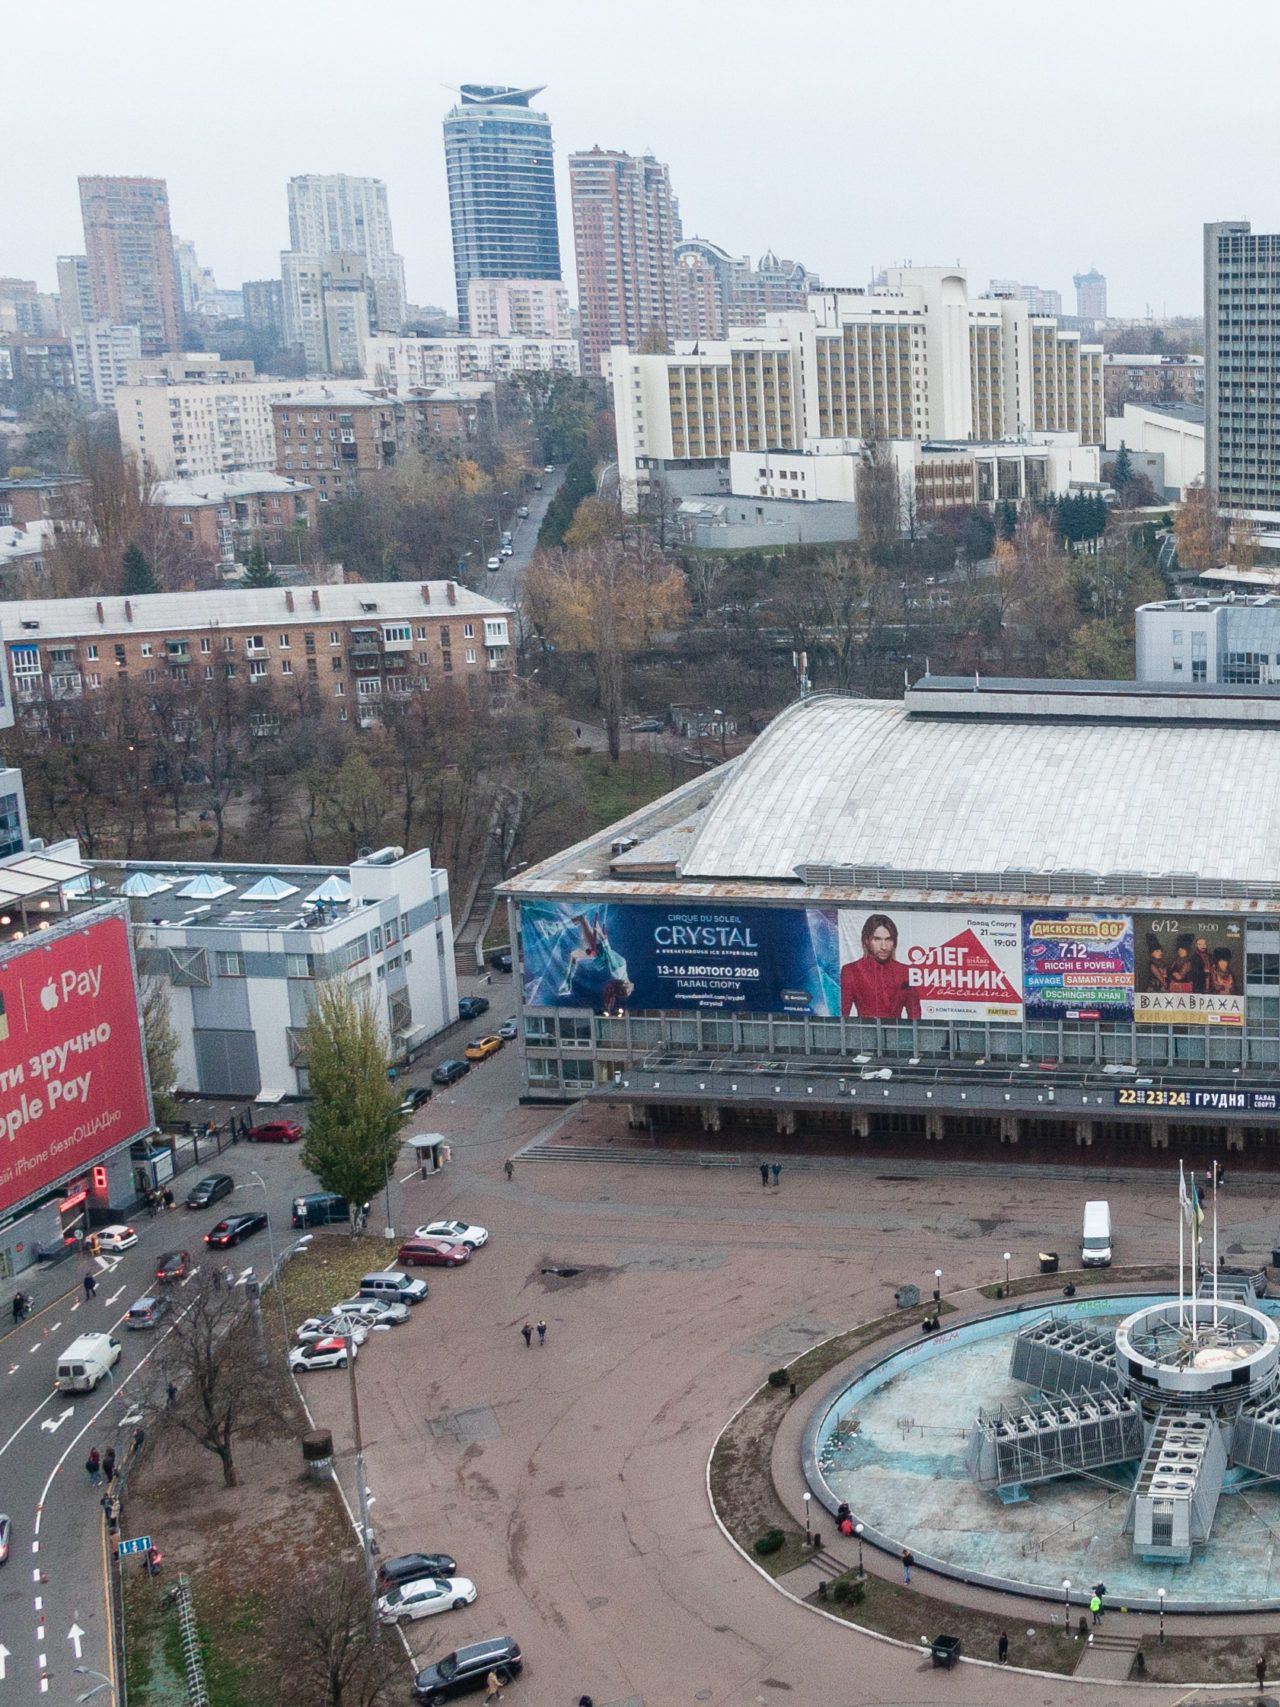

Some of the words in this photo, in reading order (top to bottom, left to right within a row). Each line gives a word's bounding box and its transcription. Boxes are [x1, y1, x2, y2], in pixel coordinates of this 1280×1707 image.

[668, 914, 699, 923] CIRQUE
[714, 915, 742, 923] SOLEIL
[991, 920, 1017, 928] Спорту
[980, 928, 988, 936] 21
[1034, 924, 1097, 935] ДИСКОТЕКА
[1151, 919, 1179, 933] 6/12
[1198, 923, 1219, 932] 19:00
[654, 925, 759, 948] CRYSTAL
[993, 939, 1017, 947] 19:00
[908, 945, 969, 966] ОЛЕГ
[1058, 942, 1087, 958] 7.12
[1044, 961, 1074, 970] RICCHI
[1075, 961, 1082, 970] E
[1084, 960, 1115, 970] POVERI
[657, 966, 686, 975] 13-16
[687, 966, 733, 976] ЛЮТОГО
[734, 967, 760, 977] 2020
[61, 964, 103, 1003] Pay
[677, 980, 708, 989] ПАЛАЦ
[709, 981, 741, 989] СПОРТУ
[908, 967, 1007, 990] ВИННИК
[1028, 977, 1061, 985] SAVAGE
[1066, 975, 1113, 984] SAMANTHA
[1114, 975, 1132, 984] FOX
[1045, 990, 1096, 999] DSCHINGHIS
[1098, 991, 1121, 1000] KHAN
[29, 1022, 112, 1080] зручно
[47, 1071, 92, 1111] Pay
[1119, 1089, 1136, 1104] 22
[1146, 1090, 1164, 1105] 23
[1168, 1091, 1187, 1106] 24
[1195, 1092, 1245, 1108] ГРУДНЯ
[15, 1150, 49, 1176] iPhone
